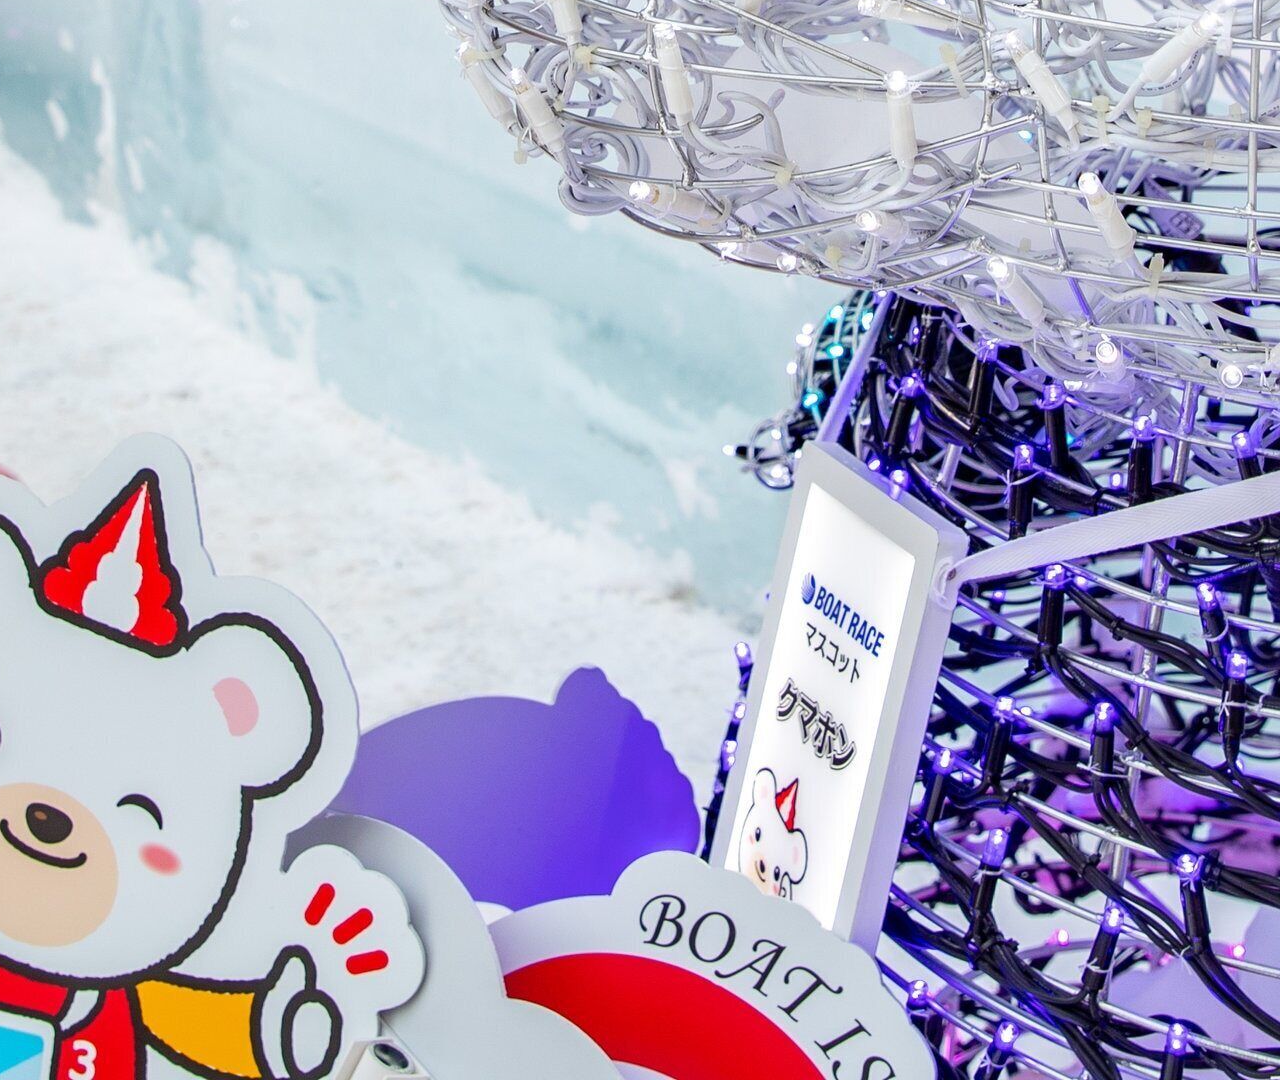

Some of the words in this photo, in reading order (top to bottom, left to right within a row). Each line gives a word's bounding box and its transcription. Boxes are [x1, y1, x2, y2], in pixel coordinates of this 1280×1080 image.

[806, 622, 860, 683] マスコット
[814, 586, 850, 628] BOAT
[847, 612, 885, 657] RACE
[776, 678, 857, 770] クマホン
[639, 894, 843, 1022] BOAT
[68, 1039, 97, 1080] 3
